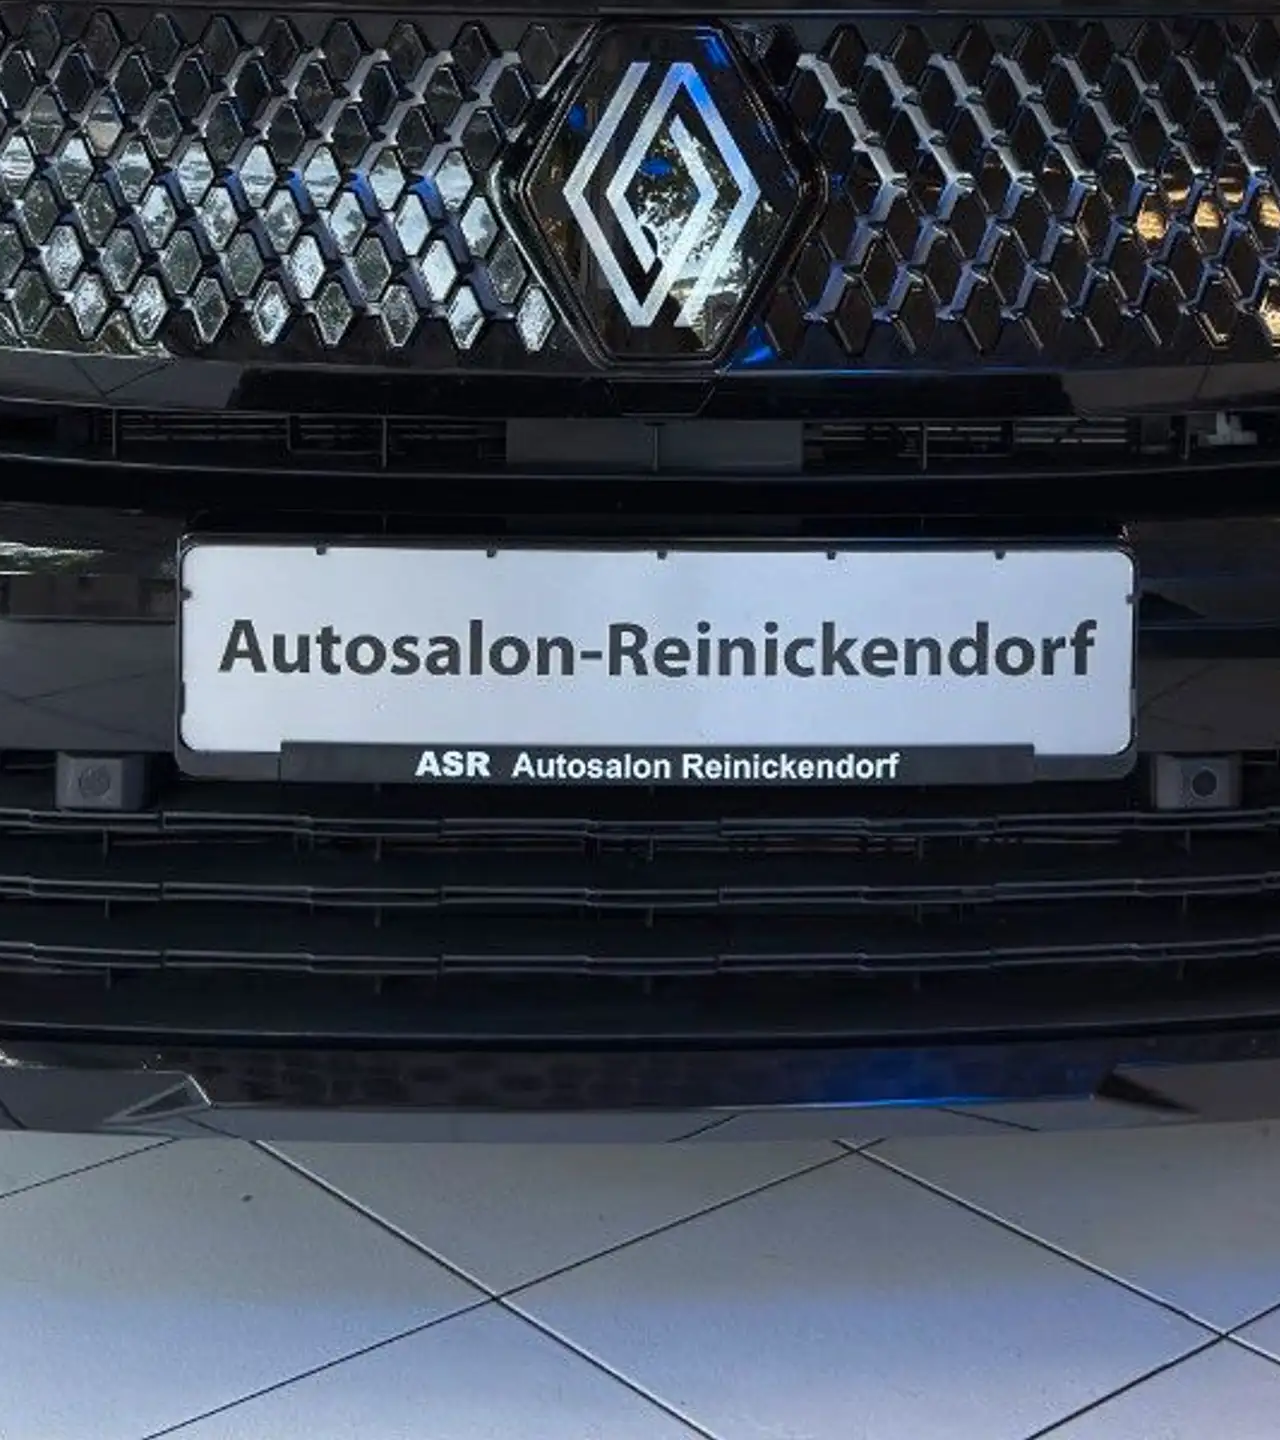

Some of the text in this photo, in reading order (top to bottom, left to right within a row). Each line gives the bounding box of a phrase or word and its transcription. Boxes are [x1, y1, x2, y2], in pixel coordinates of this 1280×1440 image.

[218, 618, 1098, 678] Autosalon-Reinickendorf
[415, 750, 901, 780] ASR Autosalon Reinickendorf
